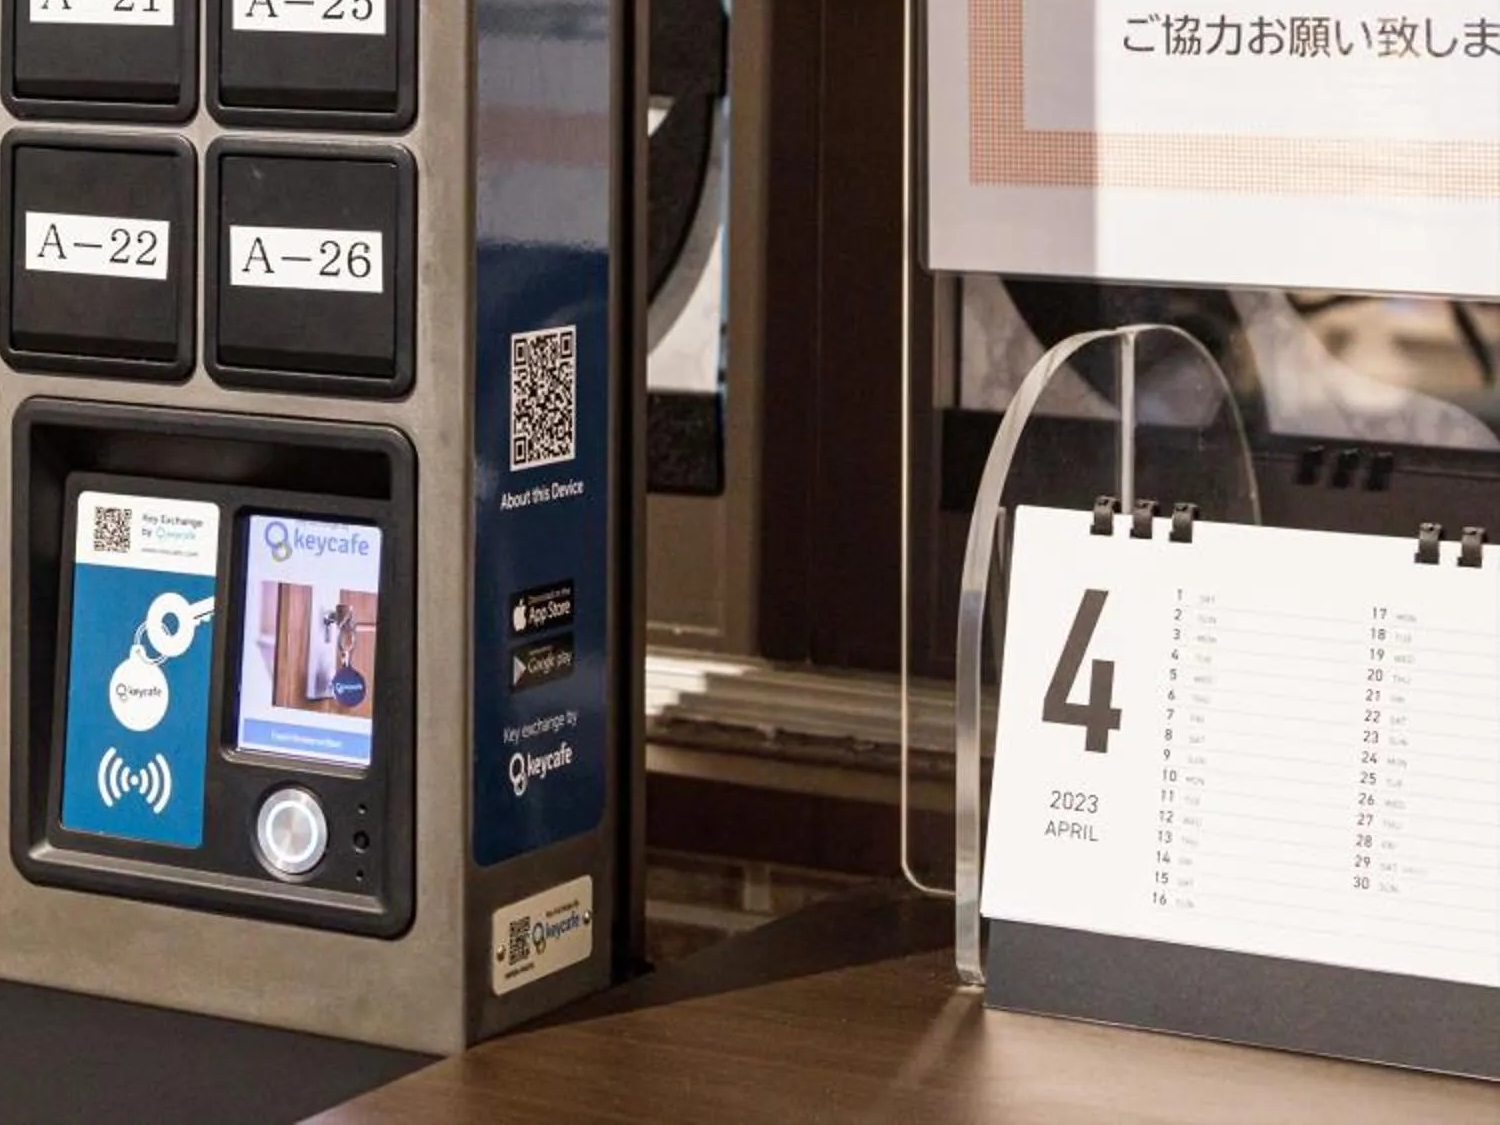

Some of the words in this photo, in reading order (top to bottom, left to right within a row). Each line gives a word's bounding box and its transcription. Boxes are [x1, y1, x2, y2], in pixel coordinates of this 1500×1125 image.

[1123, 12, 1500, 58] ご協力お願い致しま
[37, 223, 157, 266] A-22
[242, 237, 371, 278] A-26
[500, 492, 530, 511] About
[551, 478, 584, 499] Device
[294, 527, 371, 557] keycafe
[528, 607, 547, 626] App
[549, 599, 571, 619] Store
[1174, 608, 1182, 620] 2
[1372, 606, 1387, 619] 17
[1173, 628, 1181, 640] 3
[1370, 627, 1386, 640] 18
[1171, 649, 1179, 660] 4
[1370, 648, 1385, 661] 19
[1042, 588, 1122, 753] 4
[1170, 668, 1177, 680] 5
[1367, 668, 1383, 682] 20
[1168, 689, 1176, 700] 6
[1365, 688, 1381, 702] 21
[1166, 709, 1175, 720] 7
[1364, 709, 1381, 723] 22
[503, 726, 521, 746] Key
[522, 713, 565, 740] exchange
[566, 709, 579, 728] by
[1164, 729, 1173, 741] 8
[527, 741, 573, 779] keycafe
[1163, 748, 1171, 761] 9
[1361, 750, 1377, 764] 24
[1163, 769, 1177, 782] 10
[1360, 771, 1377, 785] 25
[1050, 790, 1099, 813] 2023
[1161, 789, 1174, 802] 11
[1358, 792, 1375, 806] 26
[1159, 810, 1174, 823] 12
[1357, 813, 1374, 826] 27
[1044, 820, 1099, 842] APRIL
[1158, 830, 1172, 843] 13
[1356, 833, 1373, 848] 28
[1157, 851, 1171, 863] 14
[1355, 854, 1371, 868] 29
[1155, 871, 1169, 884] 15
[1353, 875, 1370, 890] 30
[1153, 891, 1167, 905] 16
